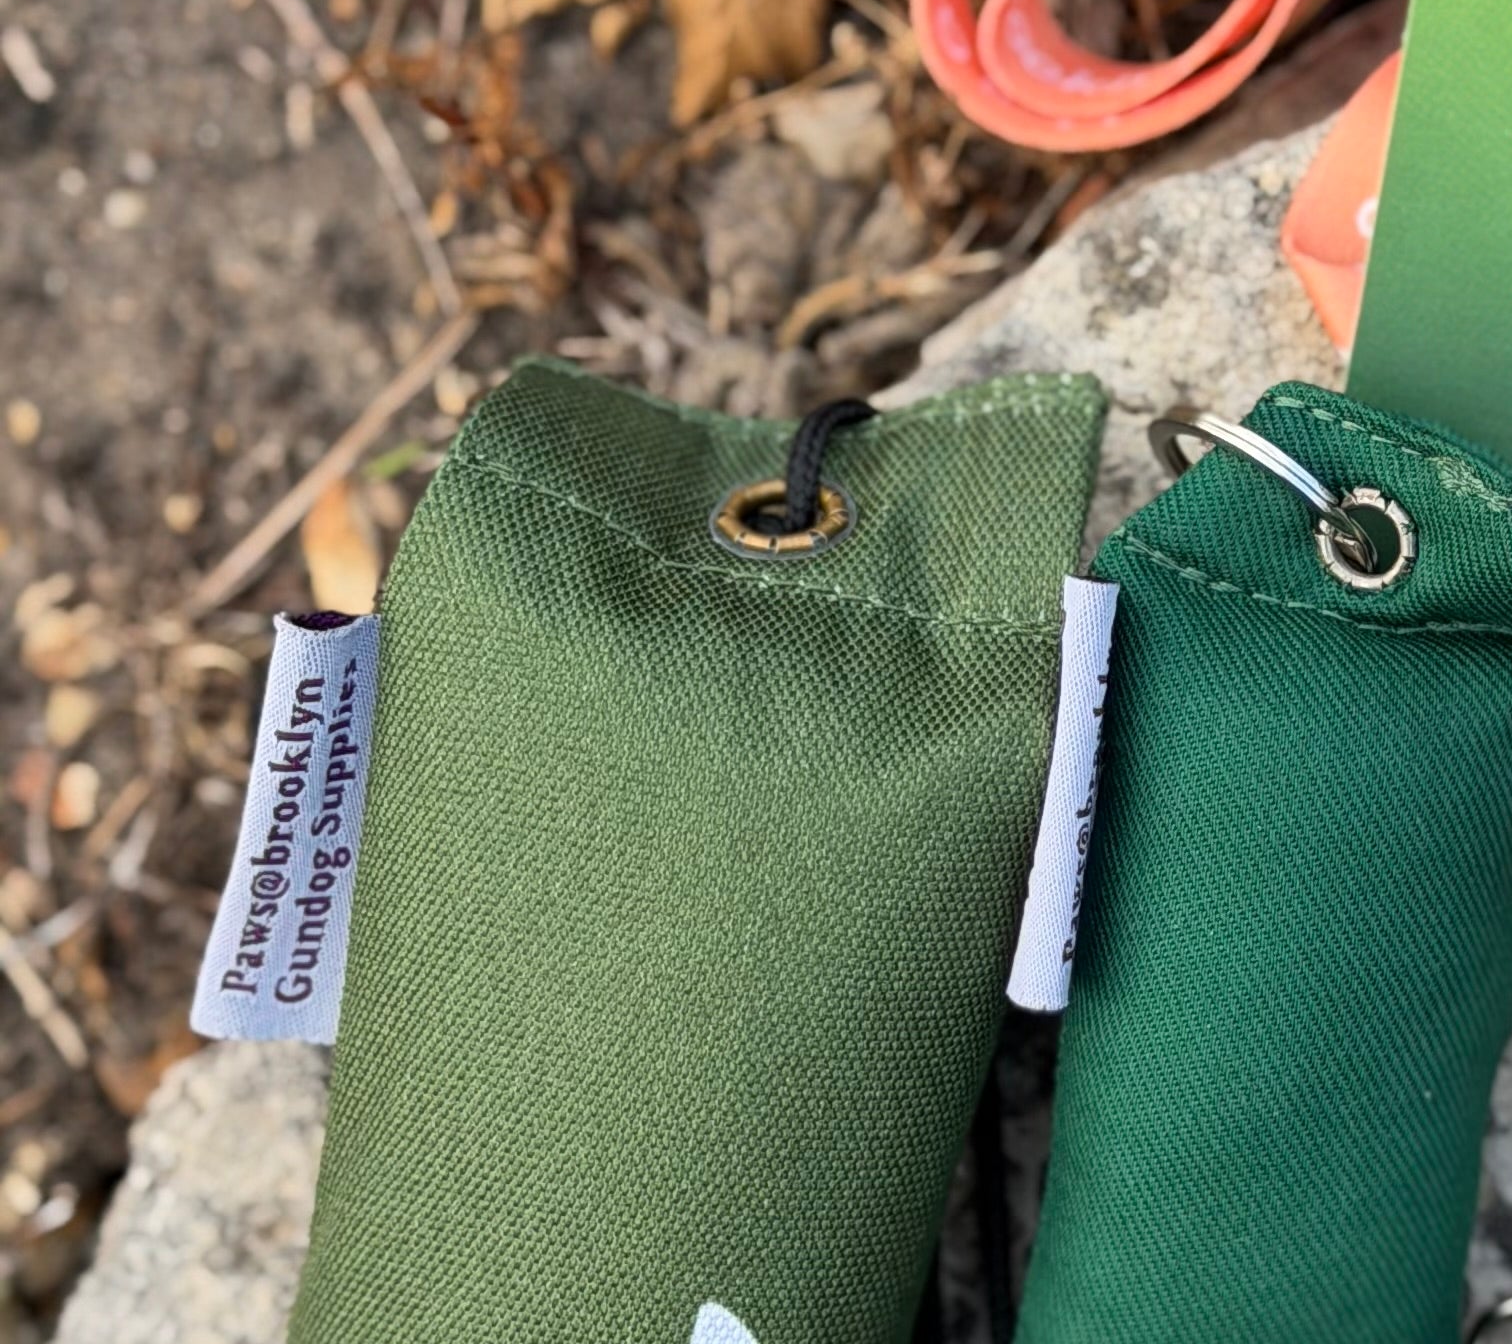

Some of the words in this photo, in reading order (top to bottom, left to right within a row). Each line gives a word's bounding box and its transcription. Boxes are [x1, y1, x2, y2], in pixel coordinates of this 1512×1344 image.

[220, 676, 325, 997] Paws@brooklyn
[311, 658, 359, 837] Supplies
[274, 846, 351, 1004] Gundog
